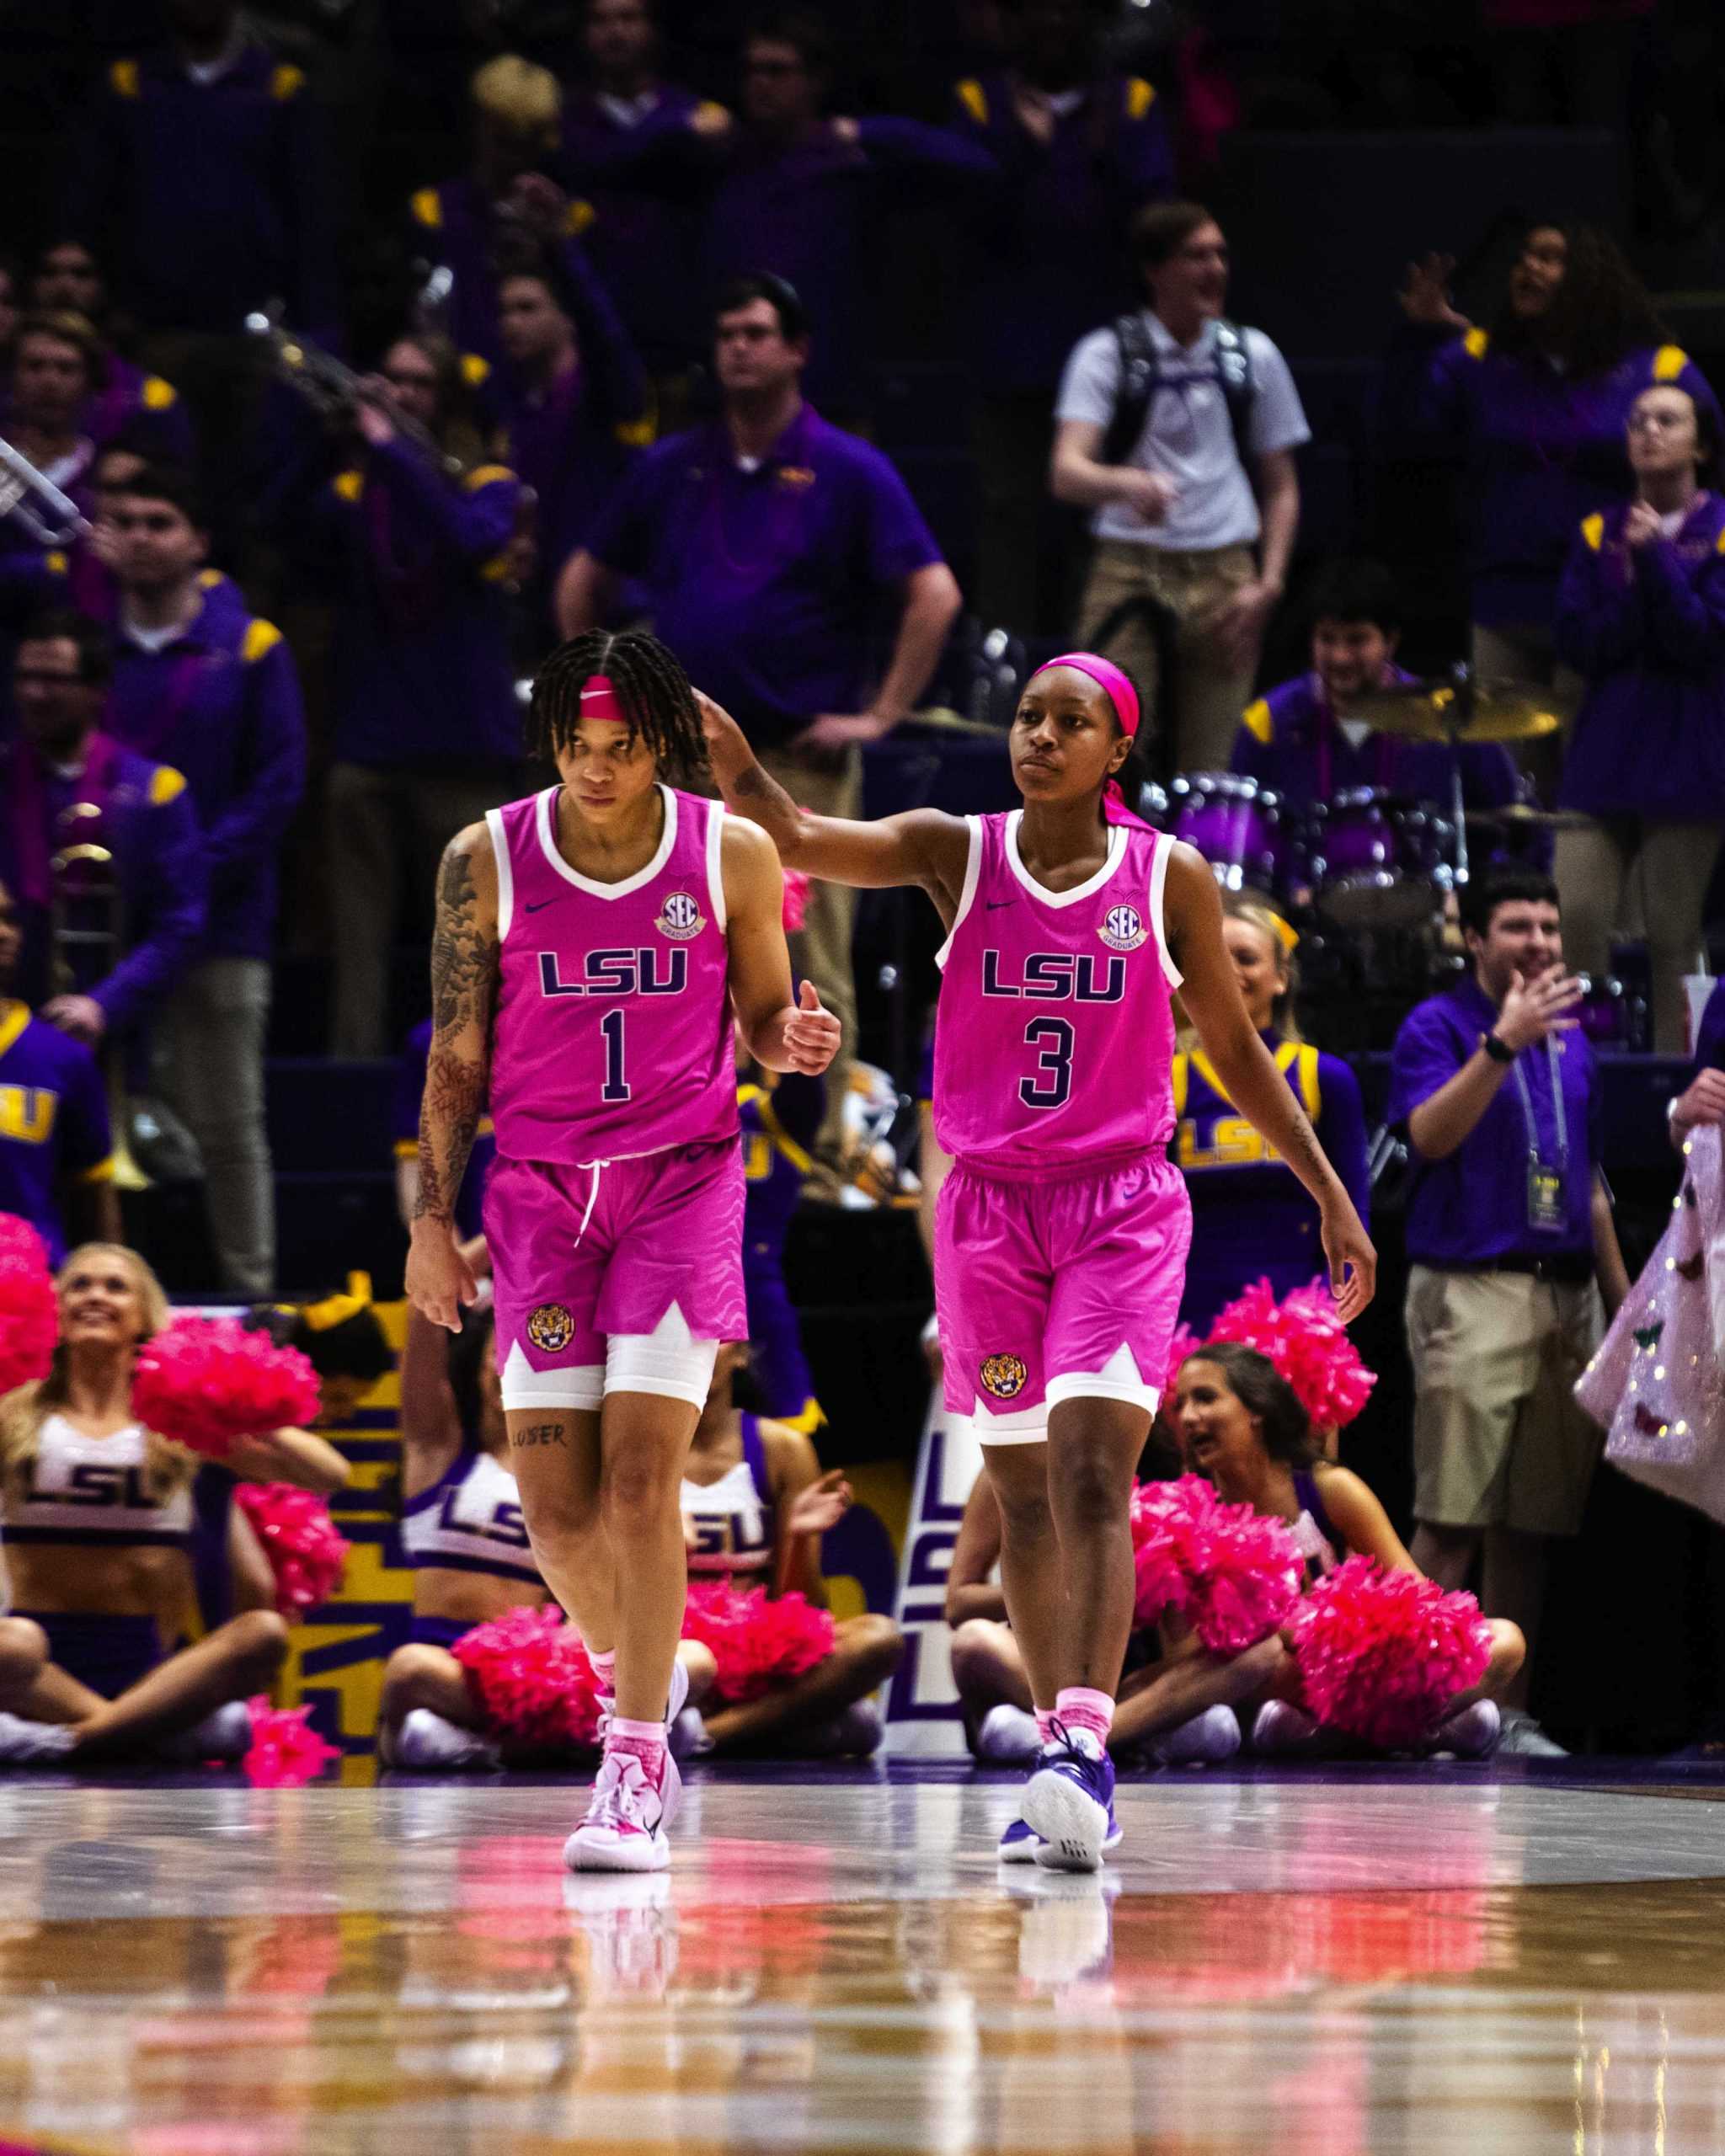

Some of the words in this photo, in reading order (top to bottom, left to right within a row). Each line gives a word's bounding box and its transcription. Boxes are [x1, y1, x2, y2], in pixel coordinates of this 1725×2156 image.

[665, 894, 697, 928] SEC
[1107, 906, 1139, 939] SEC
[1103, 935, 1142, 949] GRADUATE
[538, 948, 687, 997] LSU
[982, 949, 1126, 1003] LSU
[601, 1009, 631, 1102] 1
[1018, 1017, 1075, 1109] 3
[1178, 1116, 1284, 1170] LS
[439, 1488, 532, 1549] LS
[691, 1506, 773, 1555] SU
